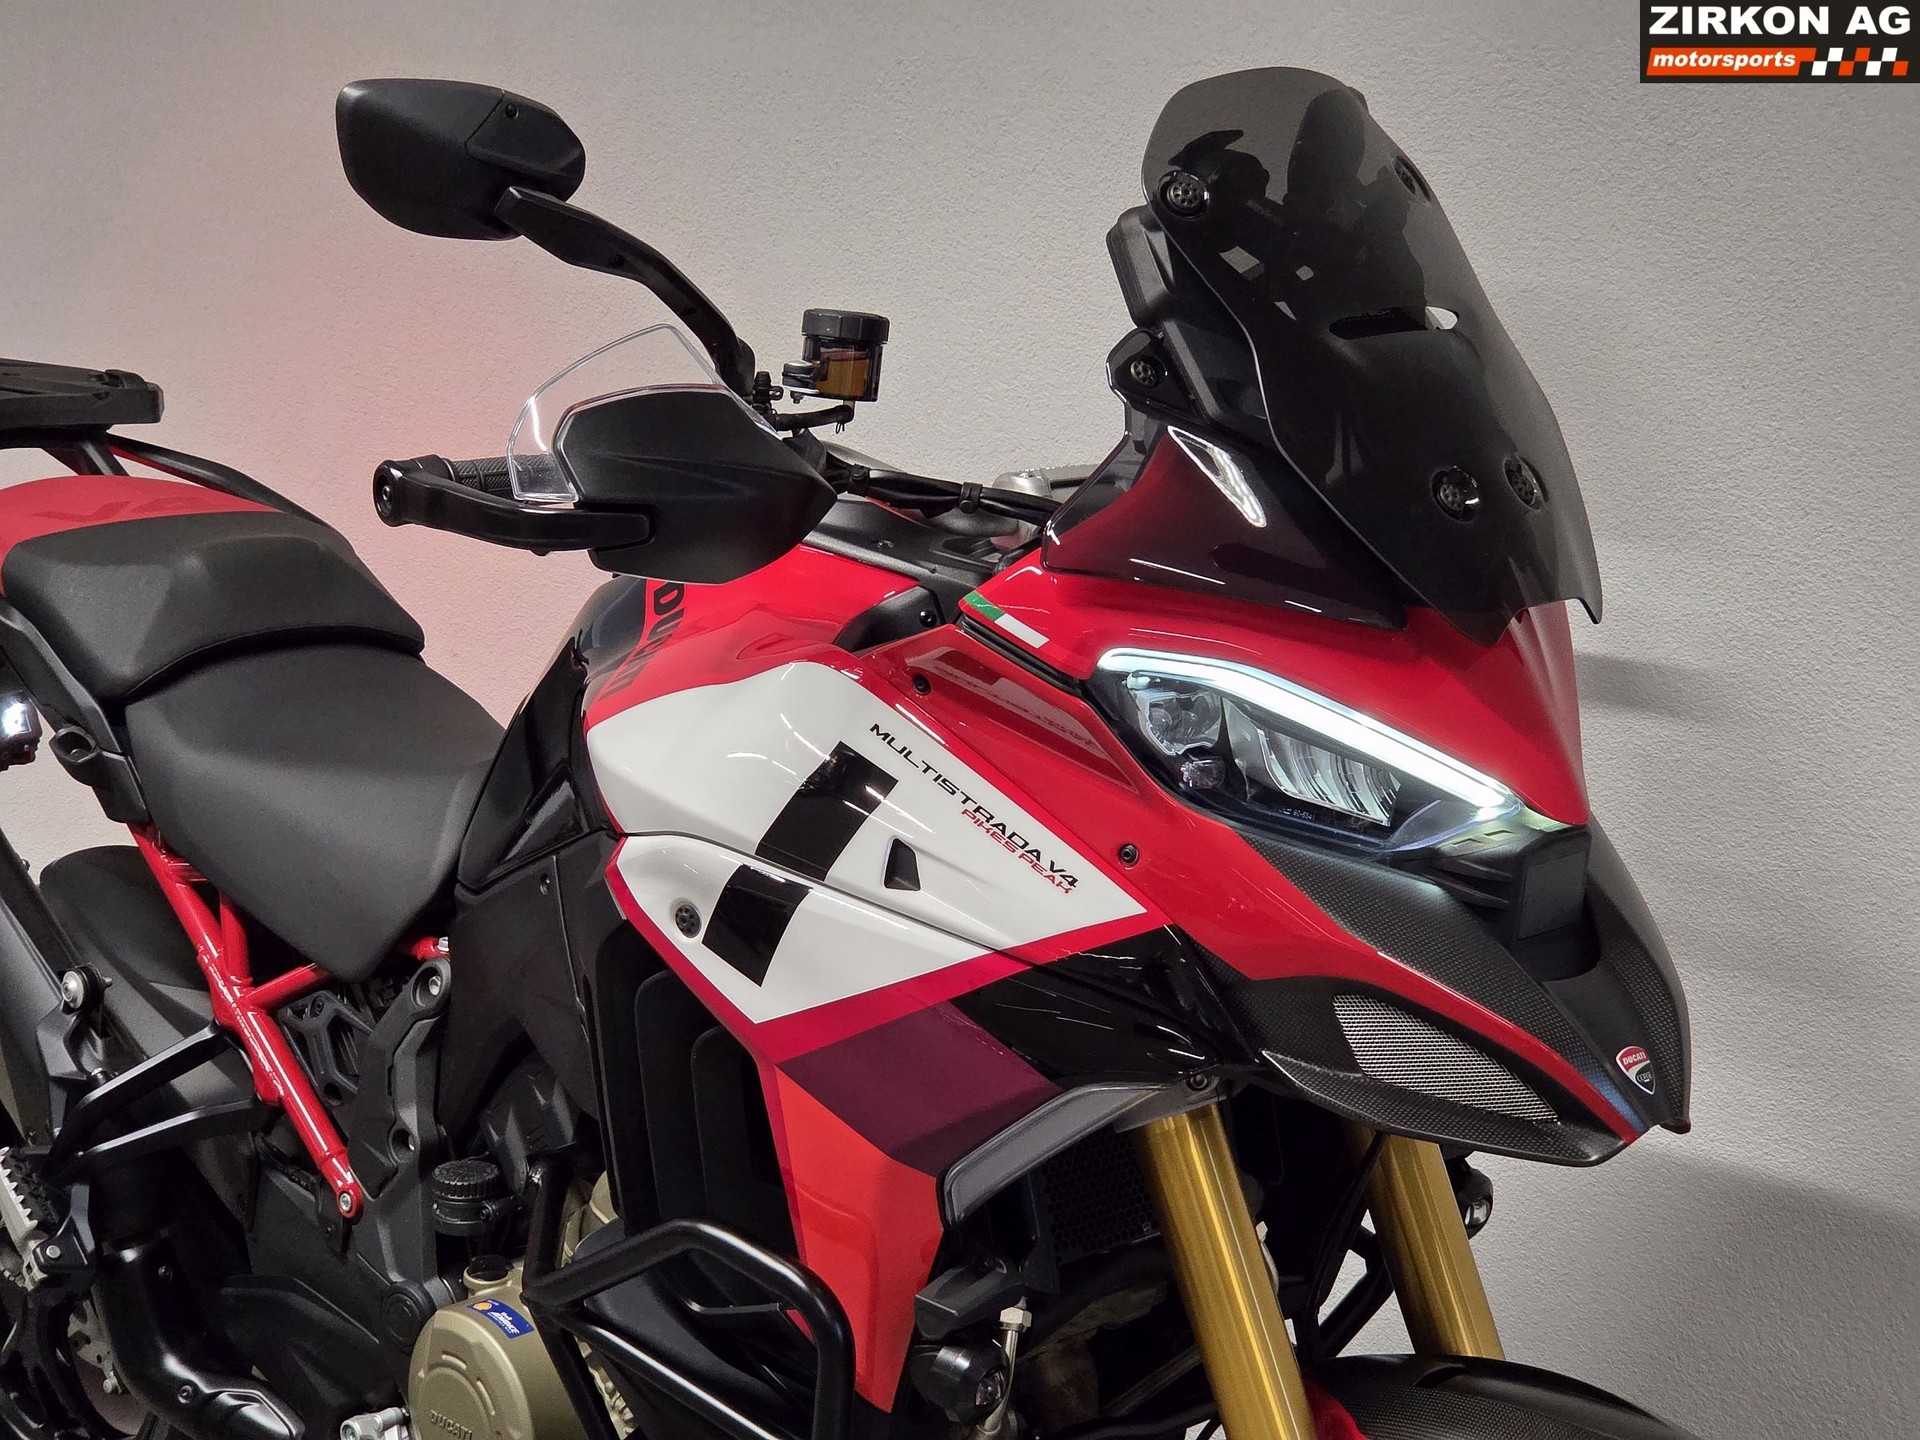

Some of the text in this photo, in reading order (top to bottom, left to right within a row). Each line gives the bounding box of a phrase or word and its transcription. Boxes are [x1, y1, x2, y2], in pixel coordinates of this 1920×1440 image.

[869, 723, 1080, 888] MULTISTRADA V4
[961, 808, 1073, 895] PIKES PEAK
[1622, 1051, 1647, 1066] DUCATI
[430, 1409, 473, 1440] DUCATI
